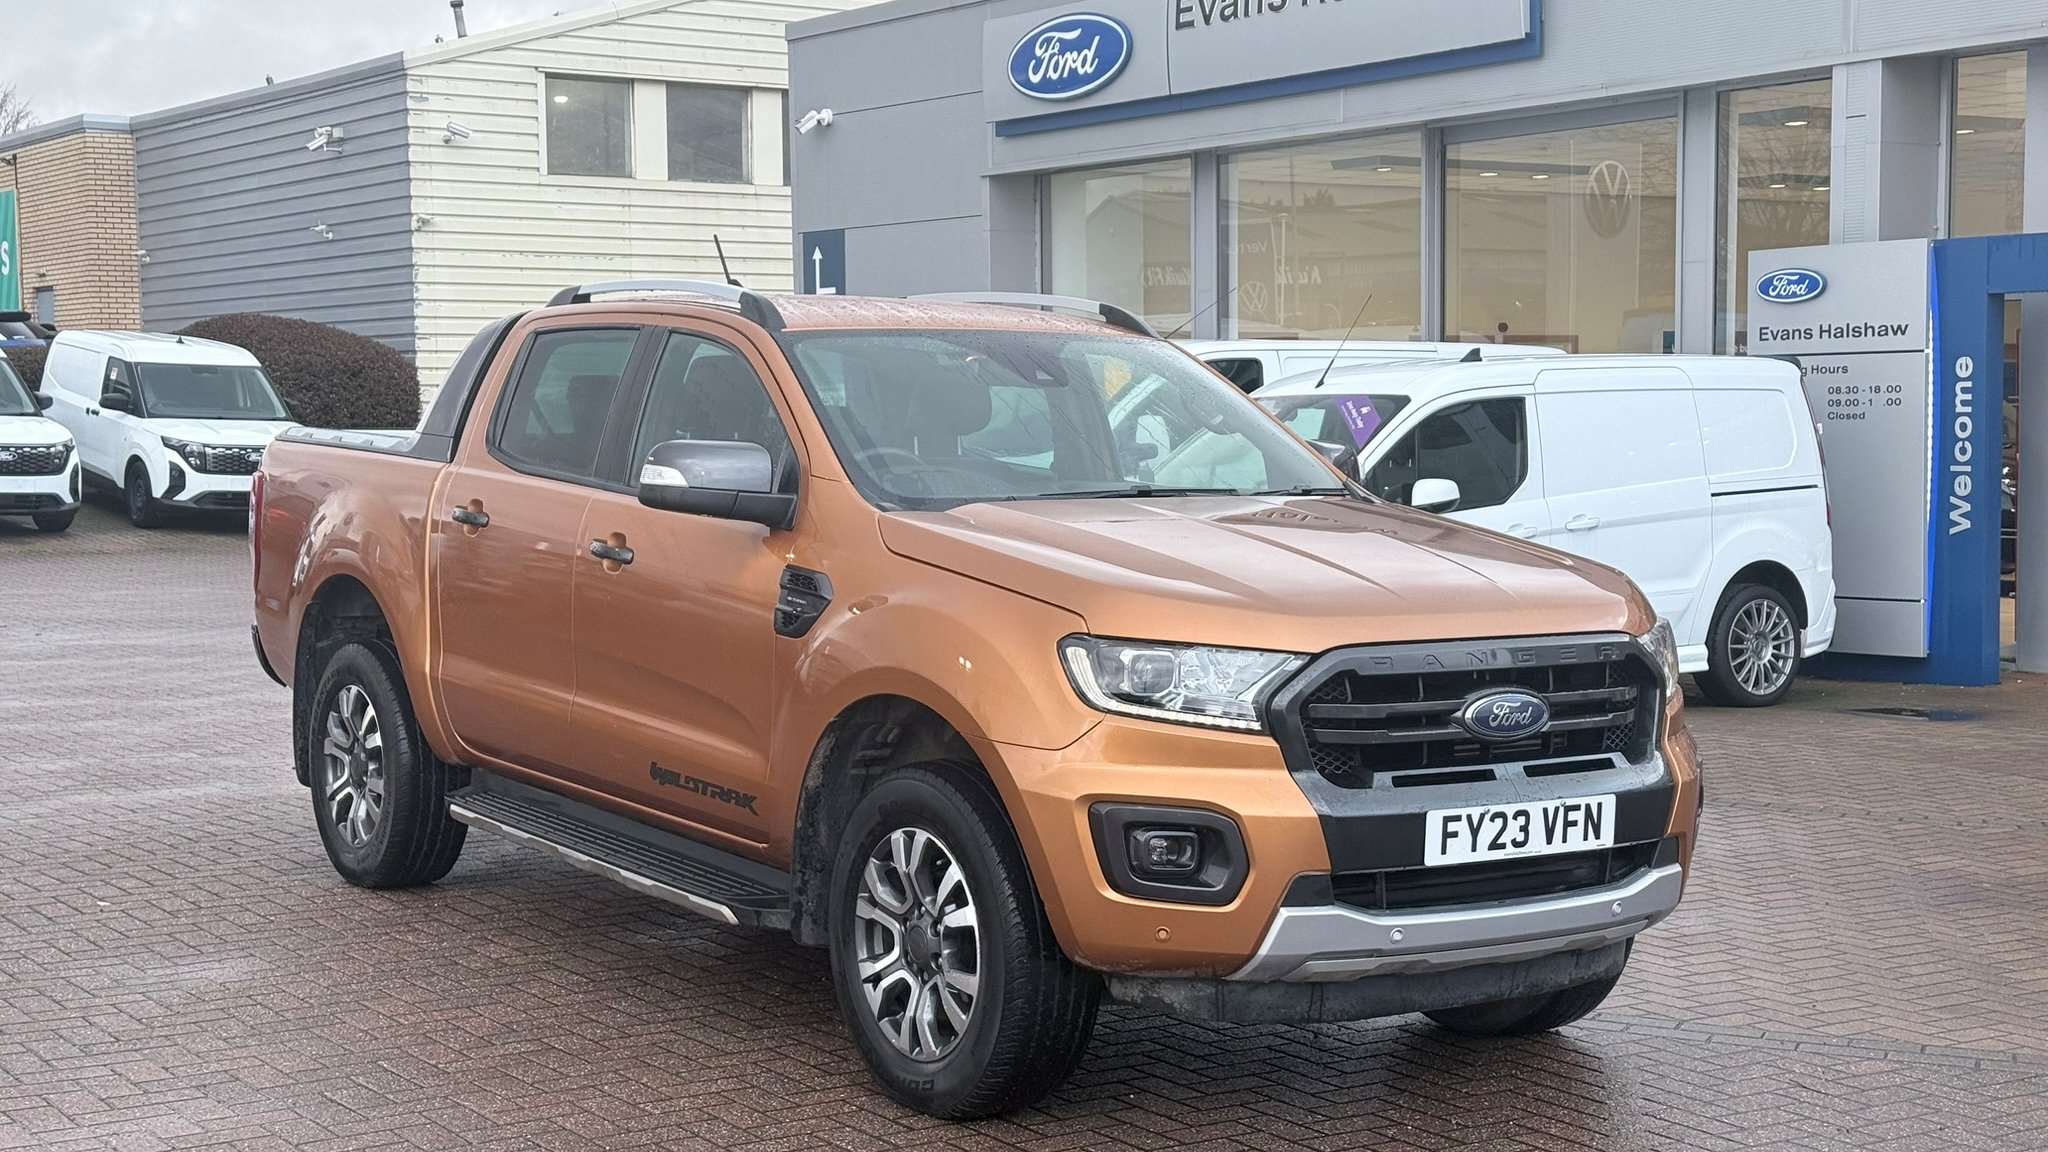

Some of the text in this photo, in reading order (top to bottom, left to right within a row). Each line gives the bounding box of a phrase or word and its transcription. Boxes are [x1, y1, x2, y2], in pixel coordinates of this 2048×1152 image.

[1027, 28, 1100, 83] Ford
[1768, 274, 1810, 297] Ford
[1759, 322, 1909, 342] Evans Halshaw
[1811, 364, 1849, 374] Hours
[1827, 385, 1859, 395] 08.30
[1827, 398, 1860, 408] 09.00
[1827, 411, 1866, 421] Closed
[1949, 356, 1974, 536] Welcome
[1368, 646, 1617, 670] RANGER
[1488, 700, 1533, 728] Ford
[1441, 802, 1603, 856] FY23 VFN
